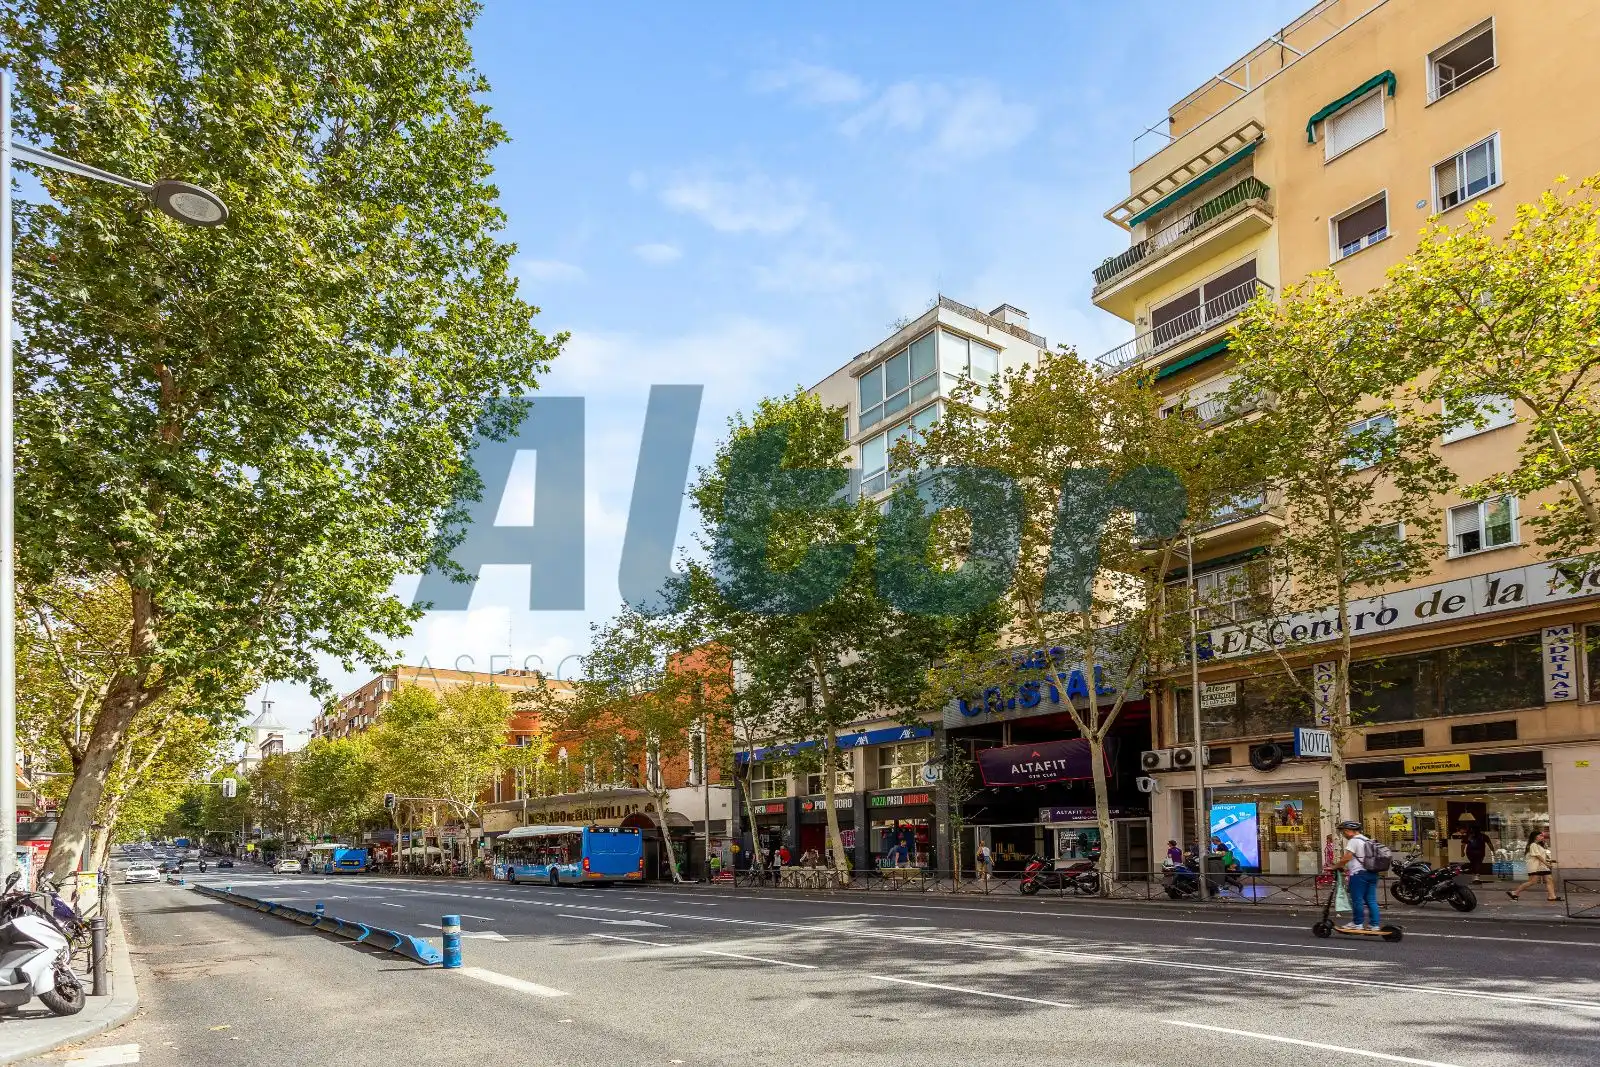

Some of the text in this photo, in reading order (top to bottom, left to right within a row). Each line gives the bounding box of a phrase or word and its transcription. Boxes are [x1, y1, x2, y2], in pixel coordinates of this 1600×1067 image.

[1414, 588, 1466, 619] de
[1482, 577, 1525, 608] la
[1546, 627, 1571, 699] MADRINAS
[959, 664, 1117, 718] CRISTAL
[1317, 663, 1333, 724] NOVIAS
[855, 736, 869, 746] AXA
[1011, 759, 1066, 774] ALTAFIT
[1412, 763, 1460, 771] UNIVERSITARIA
[815, 799, 853, 810] PODORO
[887, 795, 903, 805] PASTA
